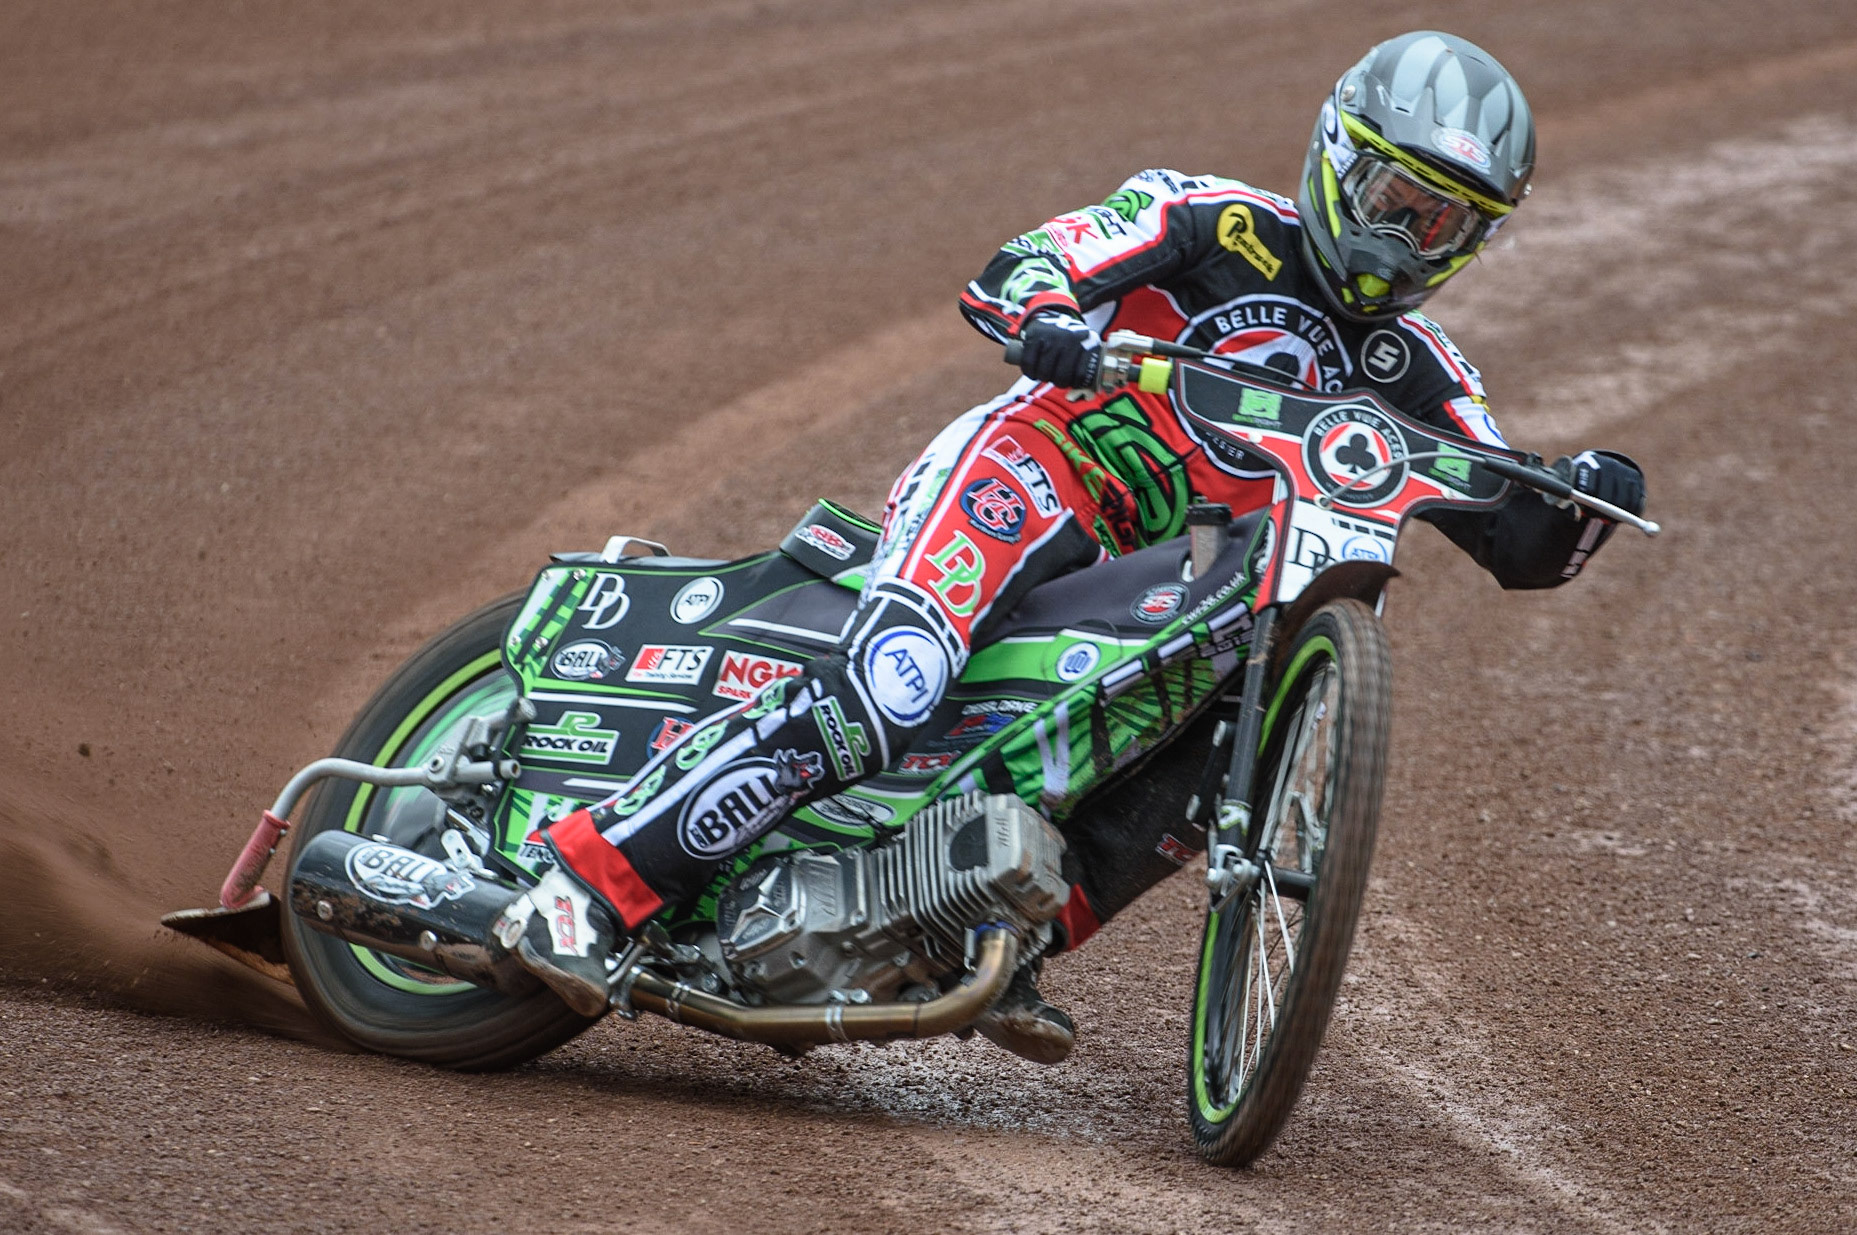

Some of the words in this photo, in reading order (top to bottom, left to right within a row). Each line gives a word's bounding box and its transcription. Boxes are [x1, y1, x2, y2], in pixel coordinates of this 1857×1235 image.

[1214, 306, 1287, 334] BELLE
[1297, 315, 1334, 356] VUE
[1322, 365, 1344, 393] AC
[1313, 410, 1349, 437] BELLE
[1352, 410, 1382, 429] VUE
[1016, 457, 1059, 512] FTS
[657, 648, 707, 671] FTS
[884, 648, 929, 703] ATPI
[524, 736, 577, 751] ROCK
[578, 739, 608, 753] OIL
[820, 704, 851, 752] ROCK
[841, 754, 855, 777] OIL
